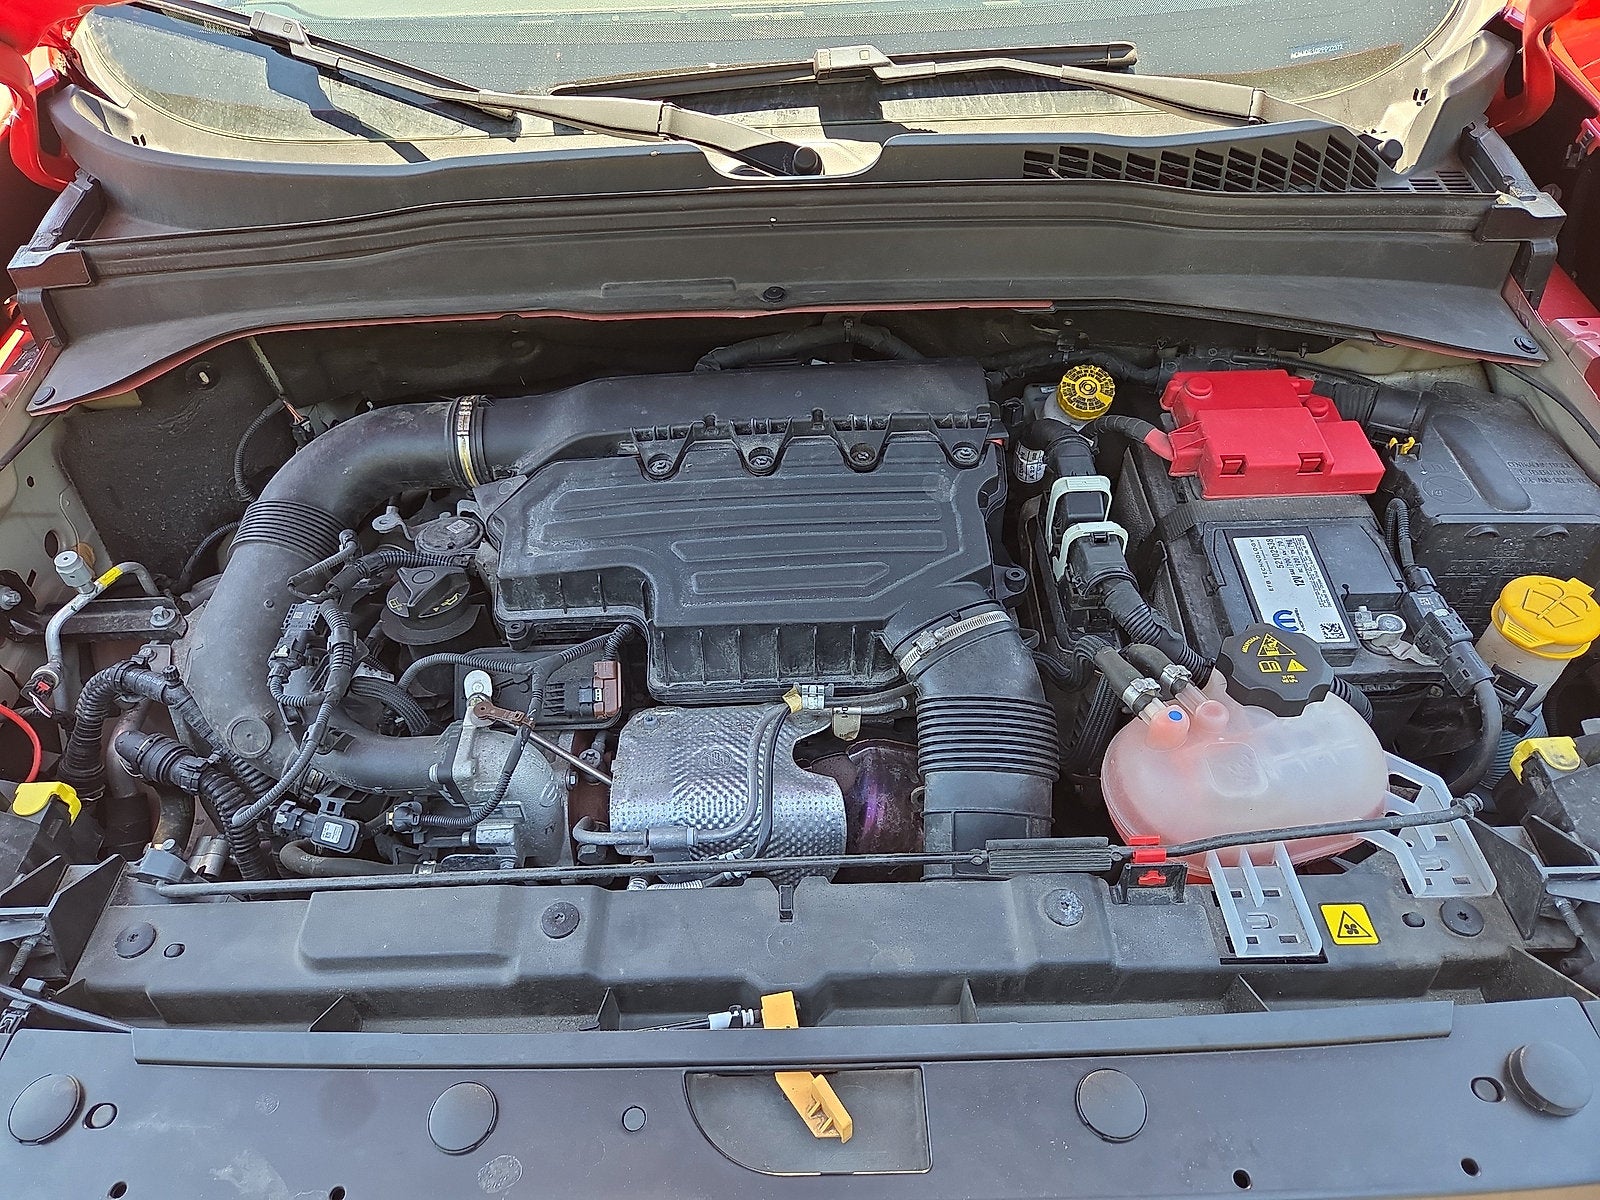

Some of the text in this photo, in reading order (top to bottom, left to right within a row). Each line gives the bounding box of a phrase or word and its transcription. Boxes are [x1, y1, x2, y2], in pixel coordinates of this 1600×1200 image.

[1248, 538, 1274, 591] EFB TECHNOLOGY
[1265, 538, 1285, 568] 52102538
[1291, 575, 1305, 586] 12V
